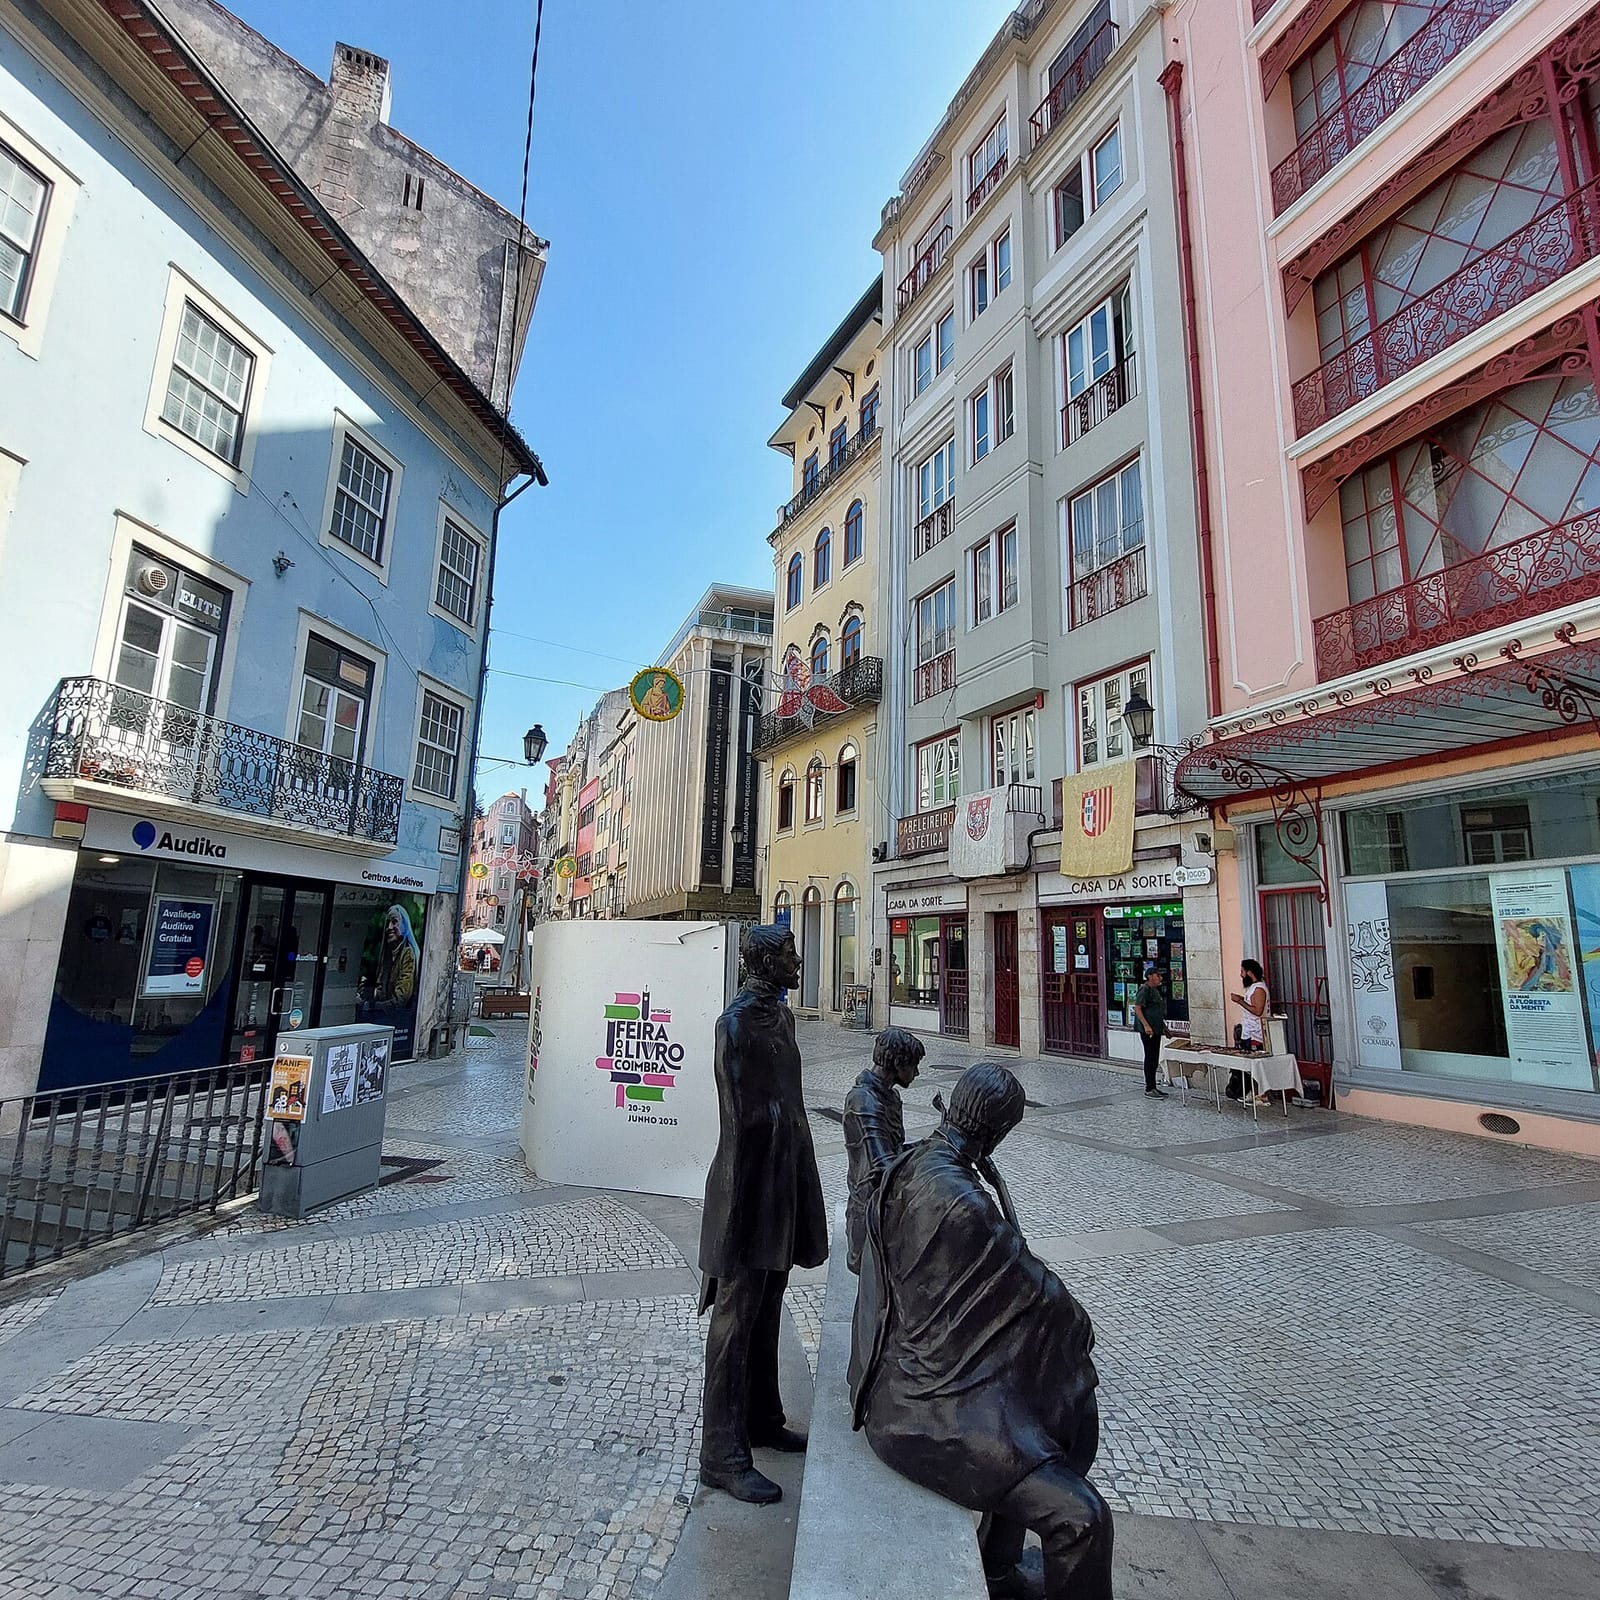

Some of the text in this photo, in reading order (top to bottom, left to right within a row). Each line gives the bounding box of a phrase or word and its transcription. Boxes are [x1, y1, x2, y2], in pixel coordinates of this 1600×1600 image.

[178, 588, 222, 618] ELITE
[712, 808, 718, 816] DE
[898, 811, 954, 836] CABELEIREIRO
[157, 832, 227, 858] Audika
[907, 832, 944, 851] ESTÉTICA
[362, 870, 424, 888] Centros Auditivos
[1072, 873, 1171, 894] CASA DA SORTE
[889, 896, 943, 910] CASA DA SORTE
[162, 909, 201, 920] Avaliação
[161, 921, 194, 931] Auditiva
[159, 933, 192, 943] Gratuita
[616, 1020, 669, 1041] FEIRA
[615, 1039, 624, 1057] DO
[1361, 1037, 1395, 1047] COIMBRA
[625, 1040, 685, 1070] LIVRO
[276, 1059, 303, 1067] MANIF
[614, 1059, 667, 1074] COIMBRA
[275, 1095, 288, 1107] 28
[628, 1104, 651, 1113] 20-29
[627, 1114, 678, 1126] JUNHO 2025
